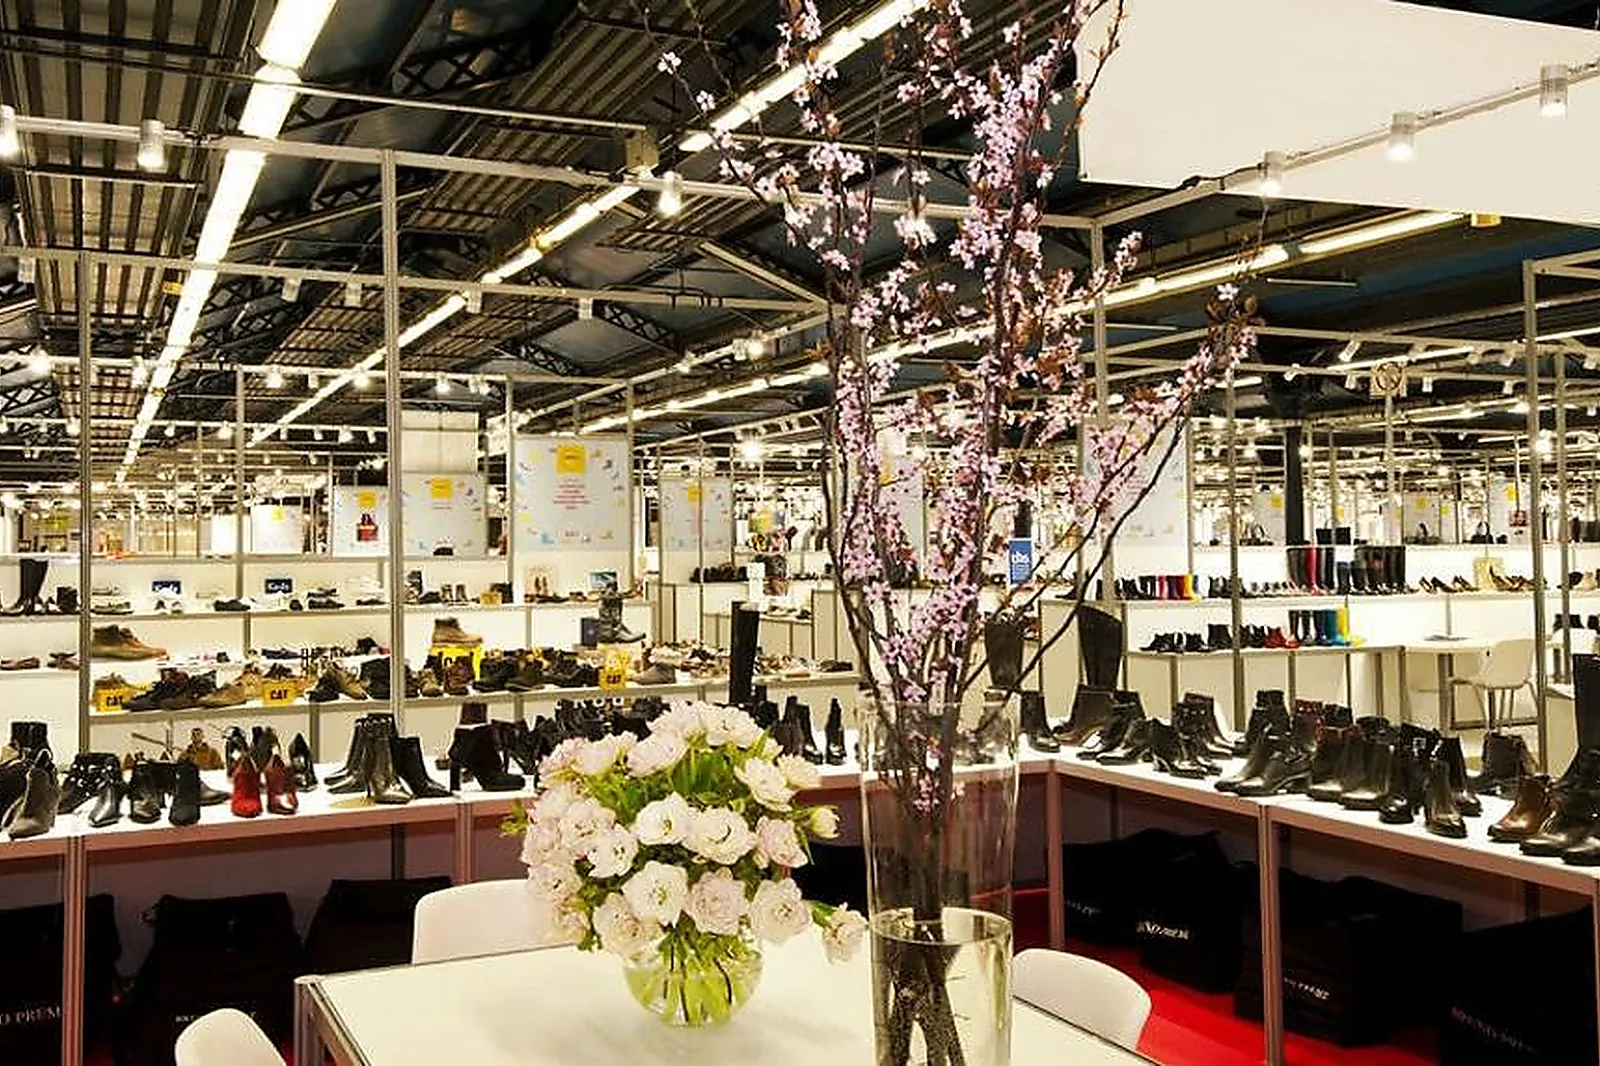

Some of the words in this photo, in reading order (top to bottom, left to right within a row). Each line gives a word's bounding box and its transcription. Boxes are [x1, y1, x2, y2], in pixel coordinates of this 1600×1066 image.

[605, 674, 622, 685] CAT
[106, 694, 124, 707] CAT
[270, 688, 288, 701] CAT
